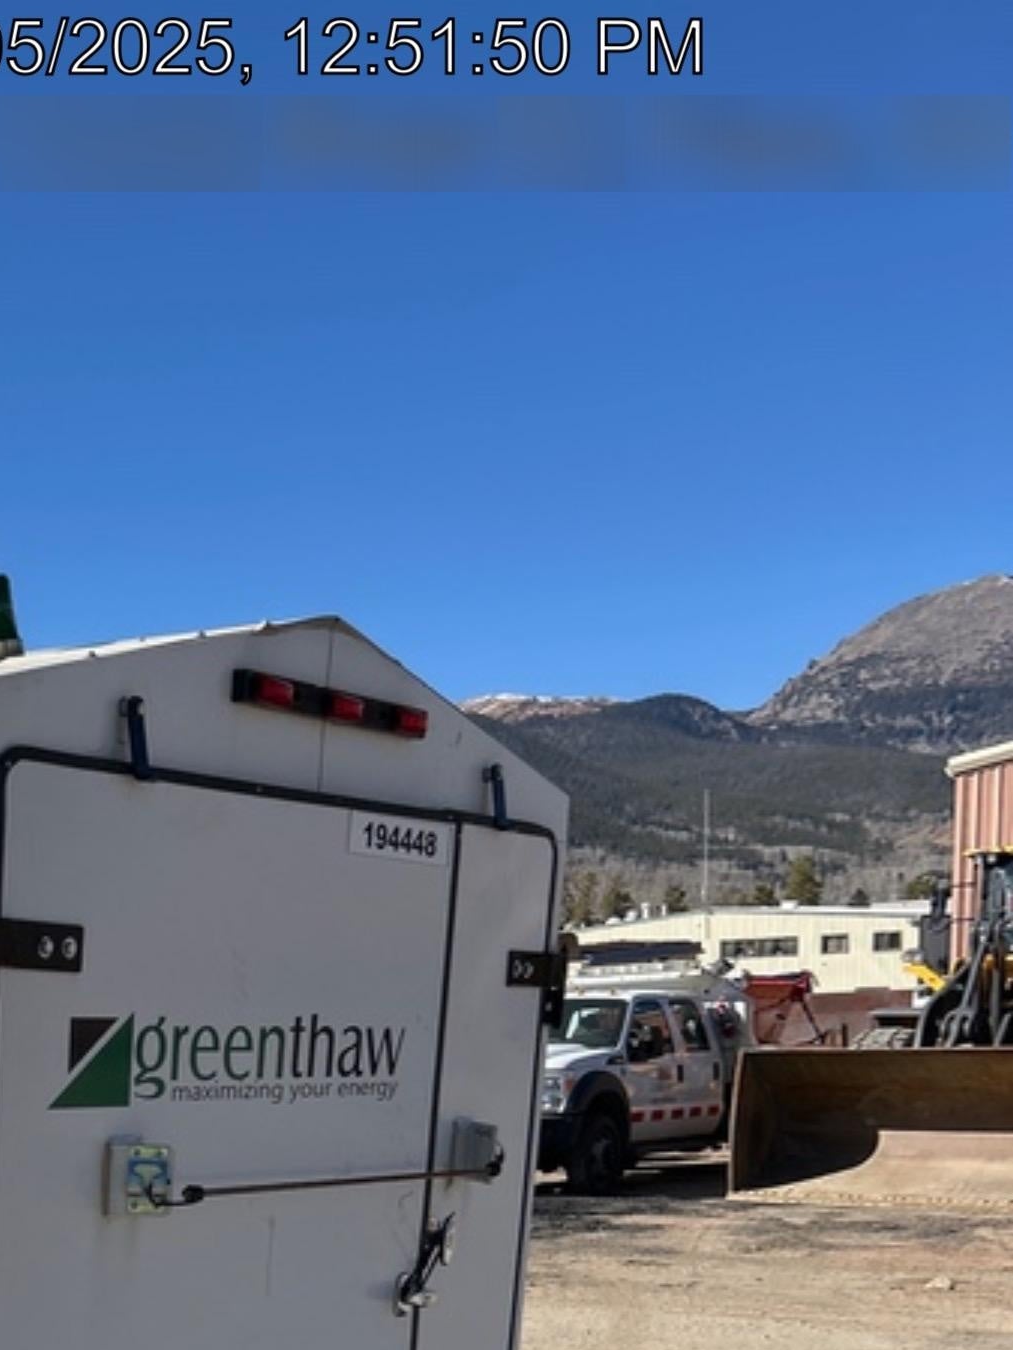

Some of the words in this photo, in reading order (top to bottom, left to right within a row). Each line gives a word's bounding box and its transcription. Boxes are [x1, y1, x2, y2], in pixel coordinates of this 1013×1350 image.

[364, 822, 438, 858] 194448
[134, 1014, 406, 1099] greenthaw
[171, 1080, 285, 1104] maximizing
[290, 1081, 333, 1103] your
[338, 1080, 399, 1101] energy
